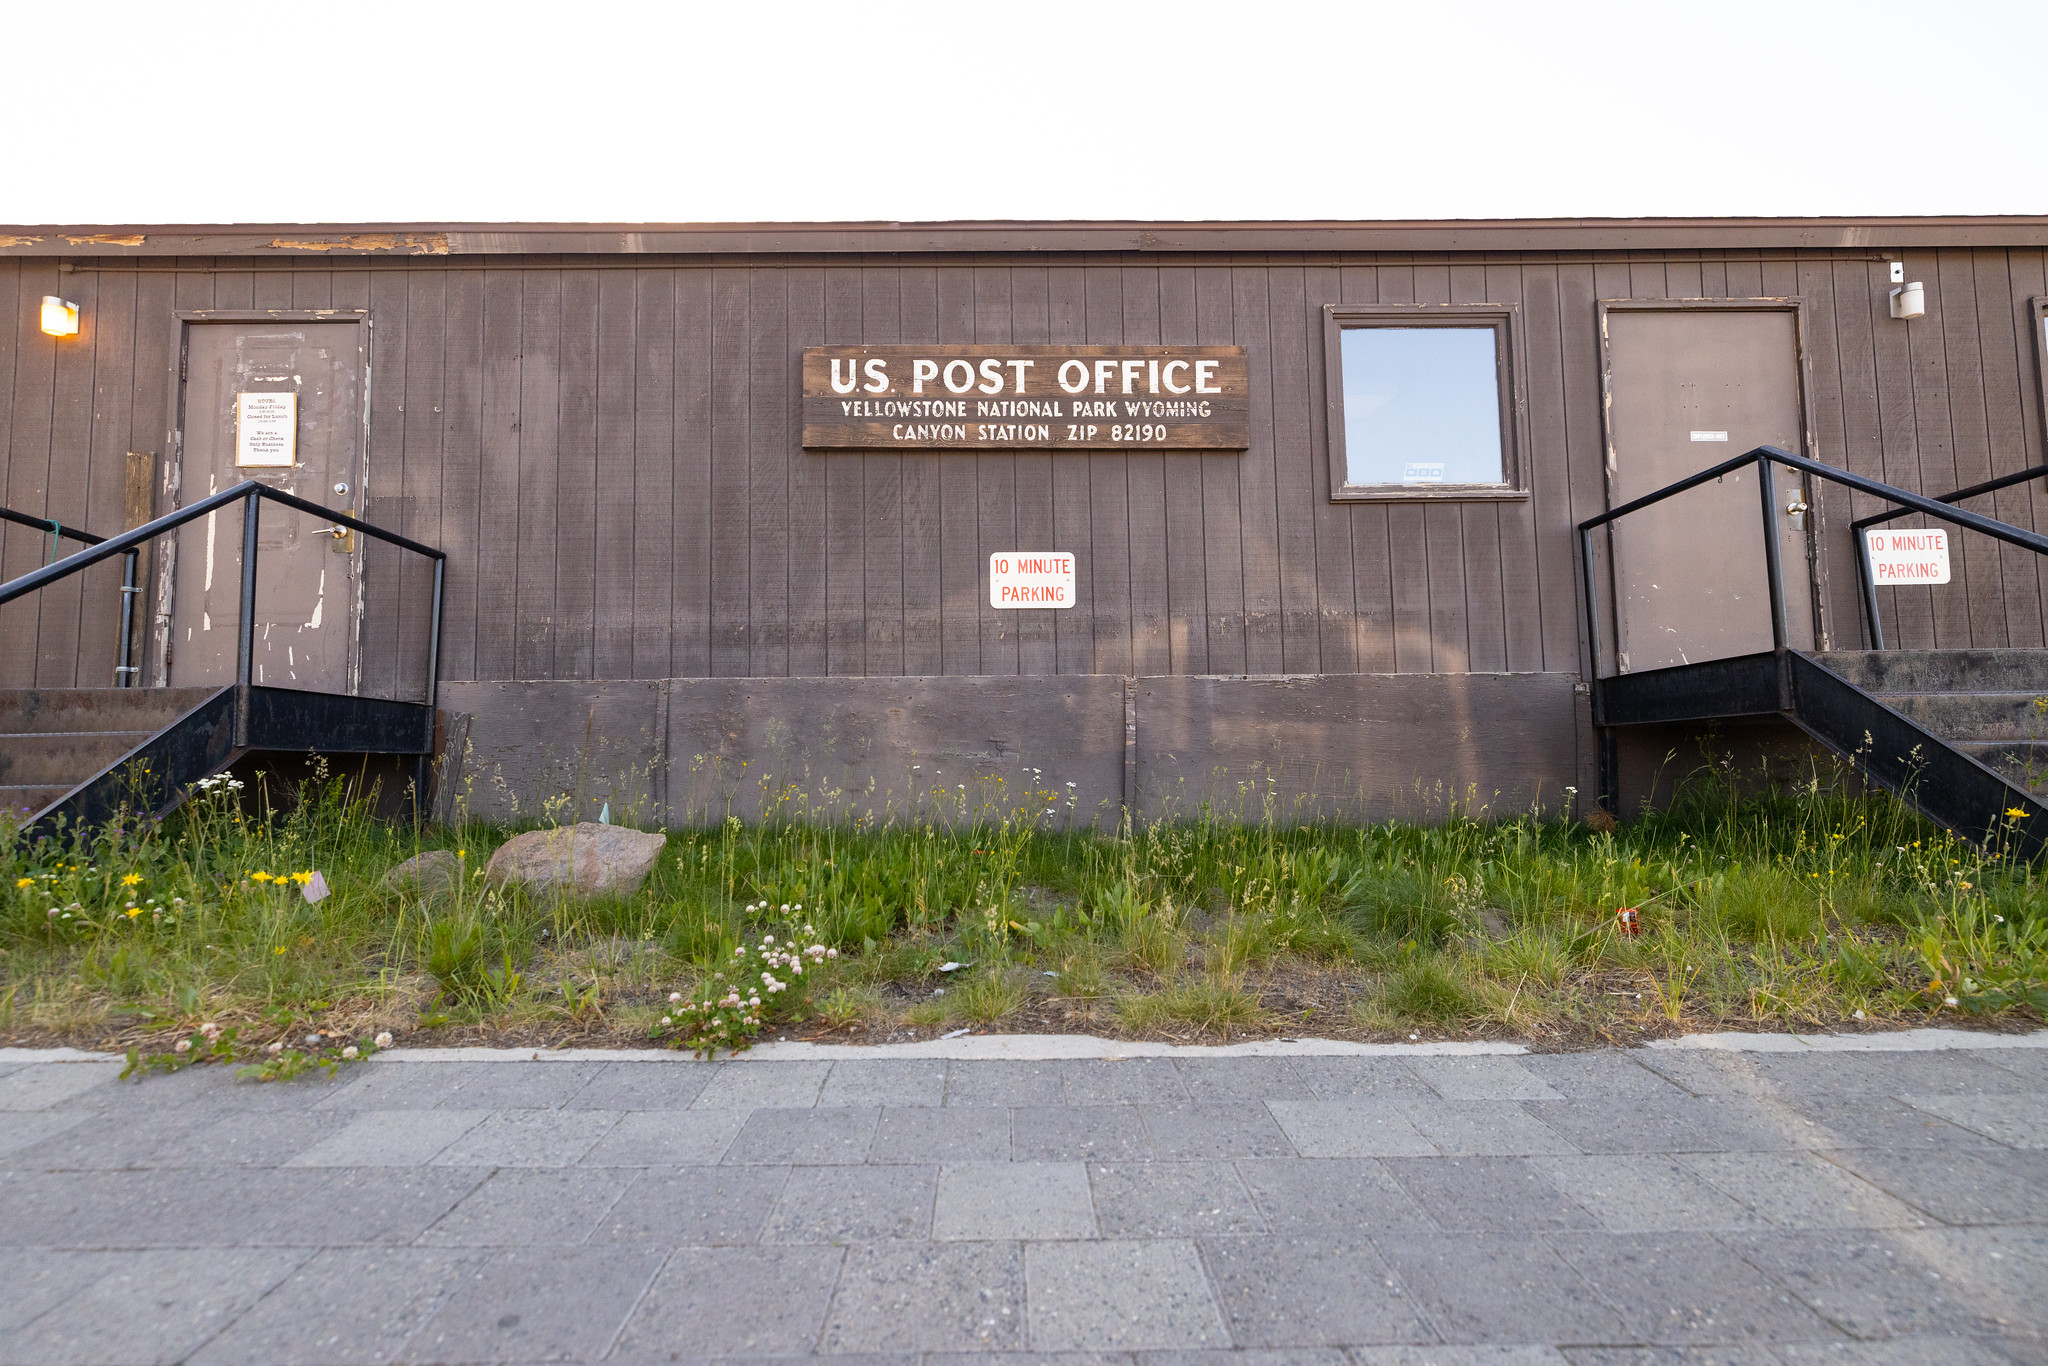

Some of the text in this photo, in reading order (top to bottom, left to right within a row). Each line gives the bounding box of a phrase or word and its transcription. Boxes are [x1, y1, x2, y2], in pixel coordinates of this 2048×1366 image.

[830, 358, 1222, 394] U.S. POST OFFICE
[841, 400, 1211, 417] YELLOWSTONE NATIONAL PARK WYOMING
[892, 424, 1167, 441] CANYON STATION ZIP 82190
[1869, 535, 1944, 551] 10 MINUTE
[995, 559, 1071, 574] 10 MINUTE
[1878, 562, 1939, 578] PARKING
[1002, 586, 1065, 602] PARKING
